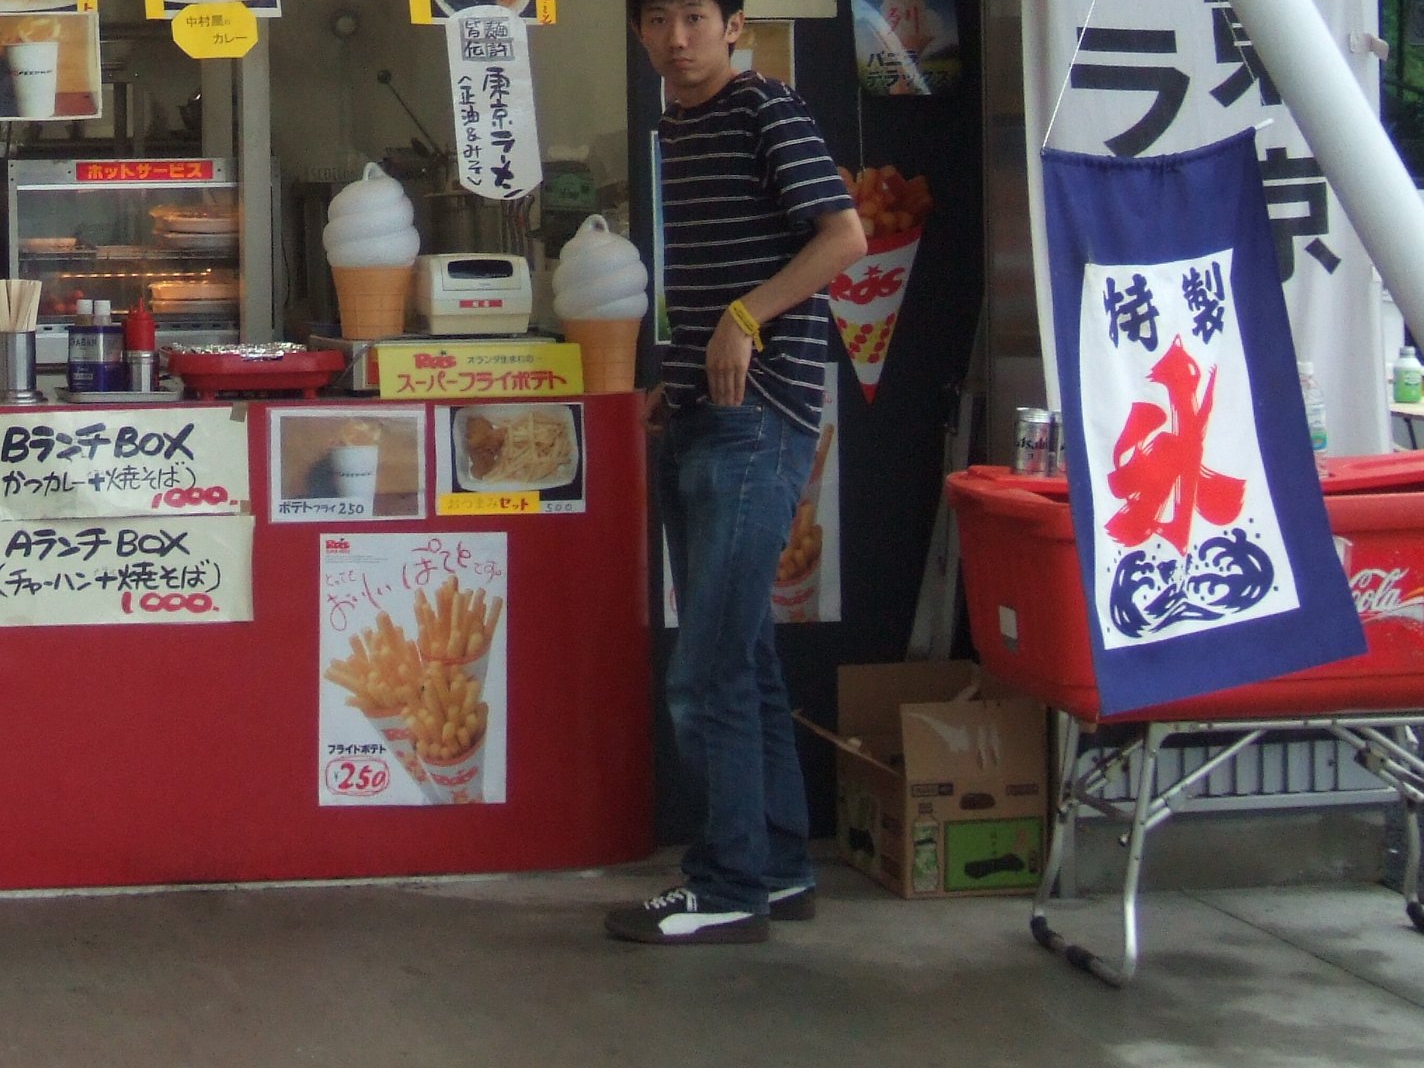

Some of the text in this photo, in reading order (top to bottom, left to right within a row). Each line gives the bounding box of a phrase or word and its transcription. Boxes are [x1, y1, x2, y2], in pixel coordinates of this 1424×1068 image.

[212, 32, 248, 45] カレー
[482, 66, 524, 199] 東京ラーメン
[85, 162, 203, 179] ホットサービス
[1102, 260, 1224, 350] 特製
[396, 370, 567, 393] スーパーフライポテト
[1105, 333, 1247, 557] 氷
[338, 501, 365, 515] 250
[545, 501, 574, 513] 500
[327, 743, 387, 755] フライドポテト
